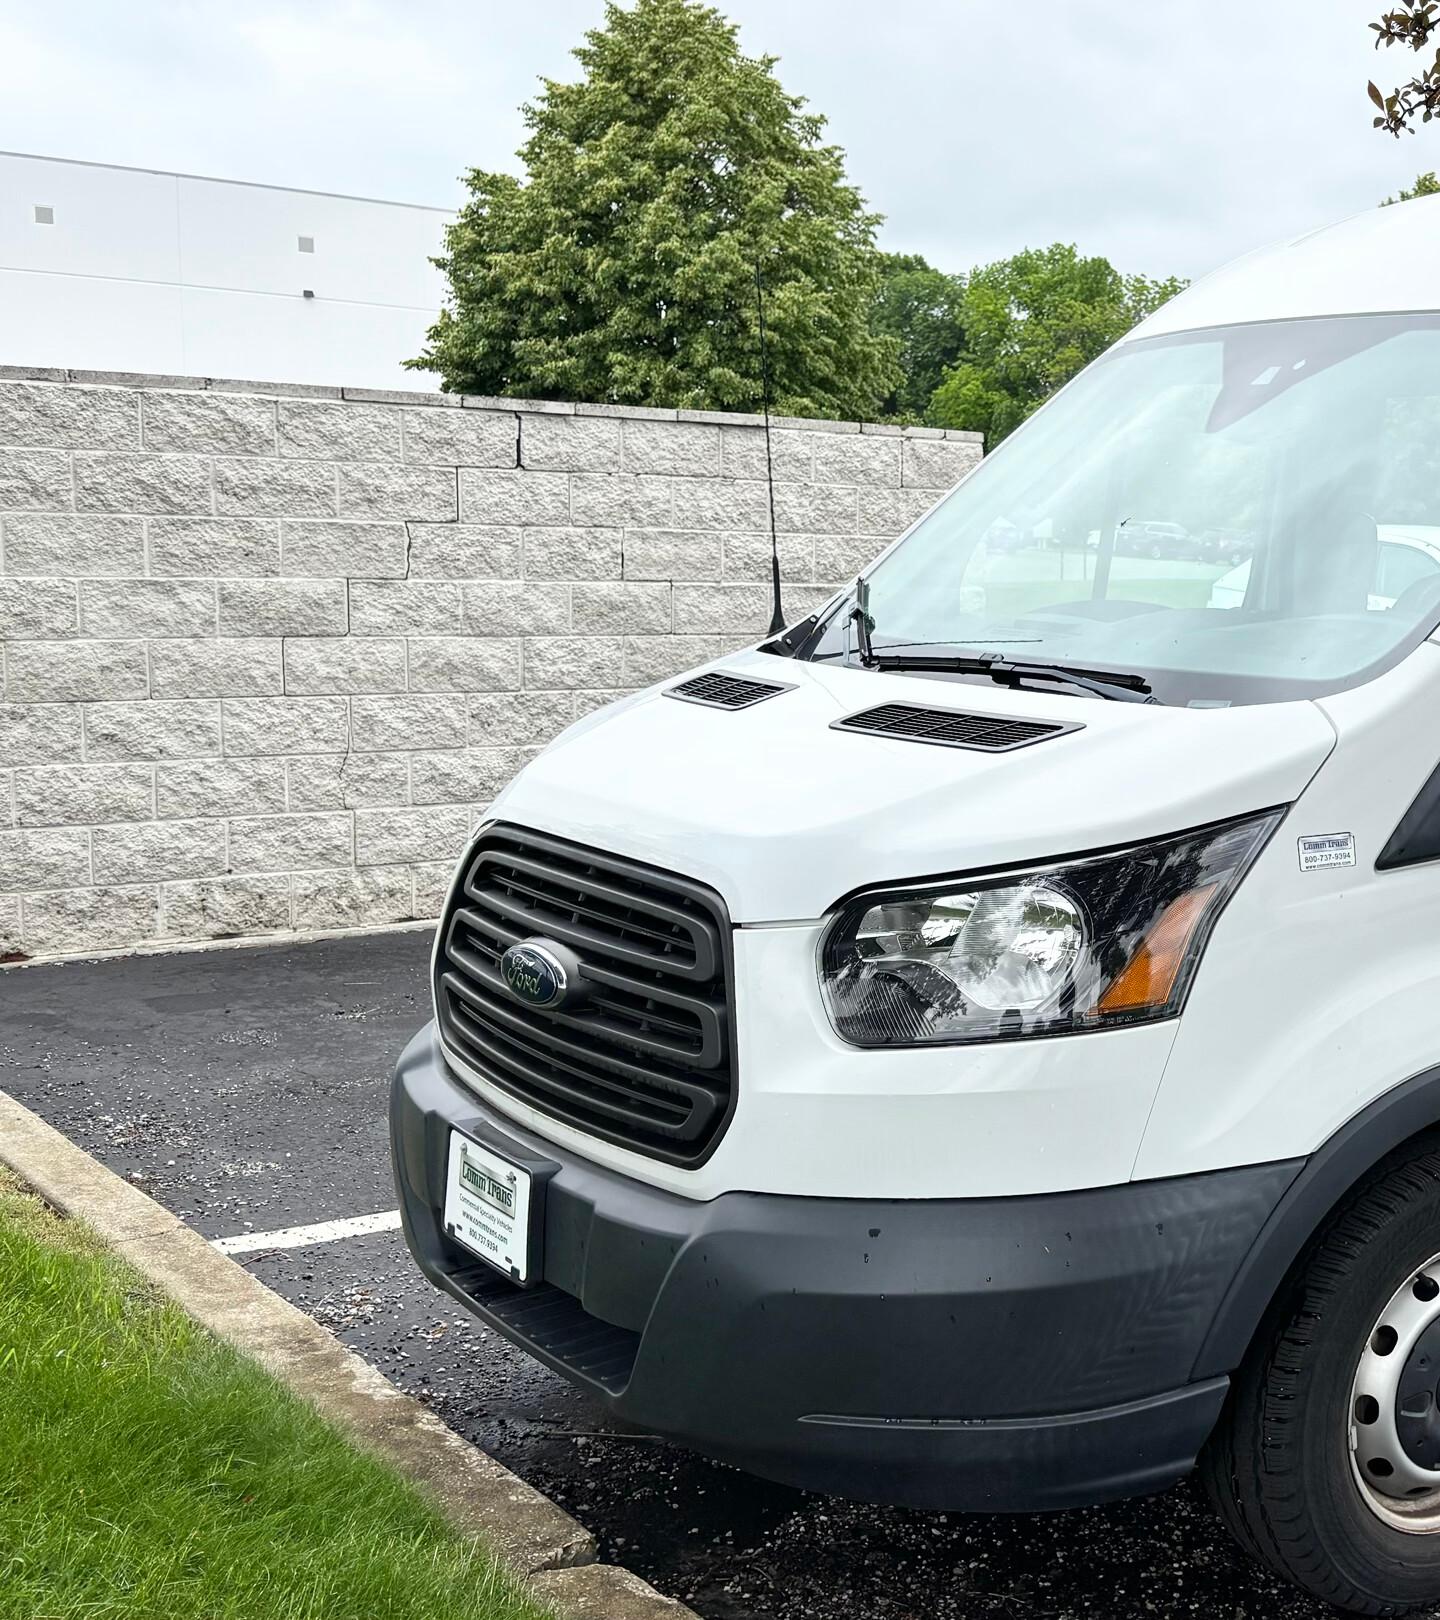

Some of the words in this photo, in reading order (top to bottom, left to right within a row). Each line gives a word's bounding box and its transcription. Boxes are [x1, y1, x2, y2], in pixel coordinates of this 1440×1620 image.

[1304, 852, 1351, 863] 800-737-9394
[507, 953, 543, 995] Ford
[487, 1175, 513, 1208] Trans
[462, 1210, 508, 1245] www.commtrans.com
[469, 1227, 498, 1253] 800.737.9394
